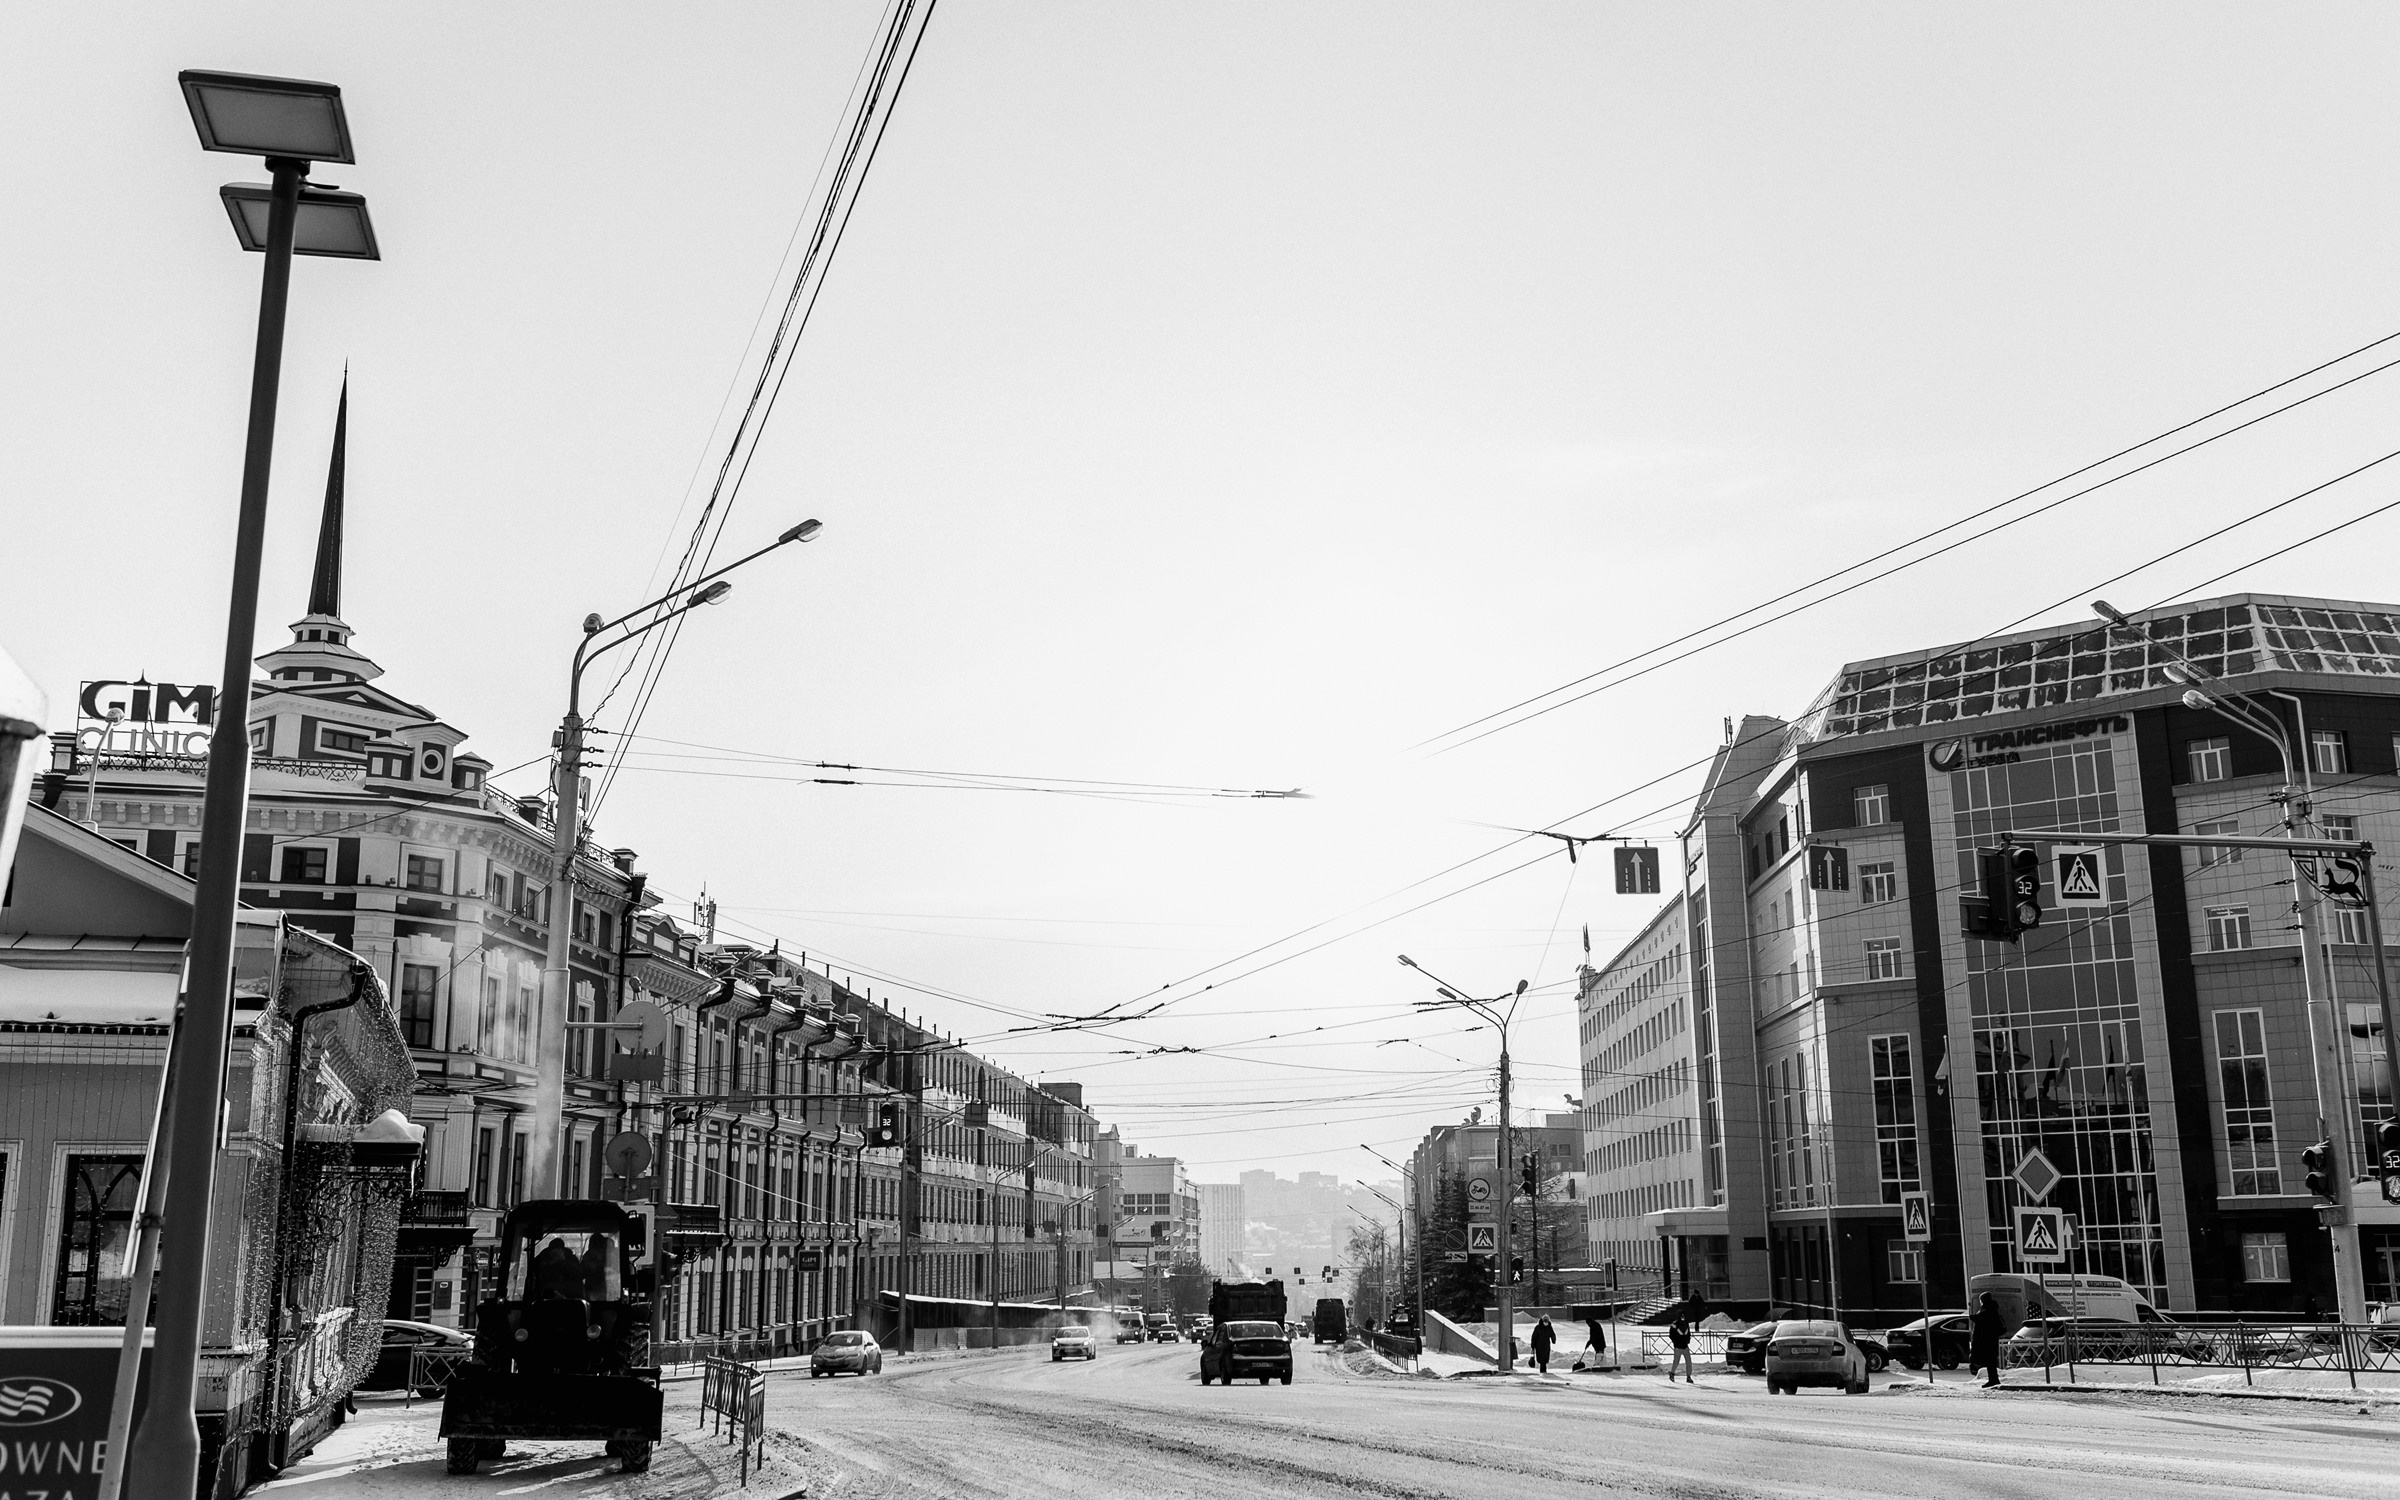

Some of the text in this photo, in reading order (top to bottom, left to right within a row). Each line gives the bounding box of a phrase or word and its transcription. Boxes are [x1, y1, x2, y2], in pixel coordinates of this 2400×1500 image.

[1972, 715, 2129, 753] ТРАНСНЕФТЬ
[76, 727, 210, 759] CLINIC
[2018, 881, 2032, 895] 32
[882, 1118, 892, 1127] 32
[2385, 1155, 2400, 1169] 32
